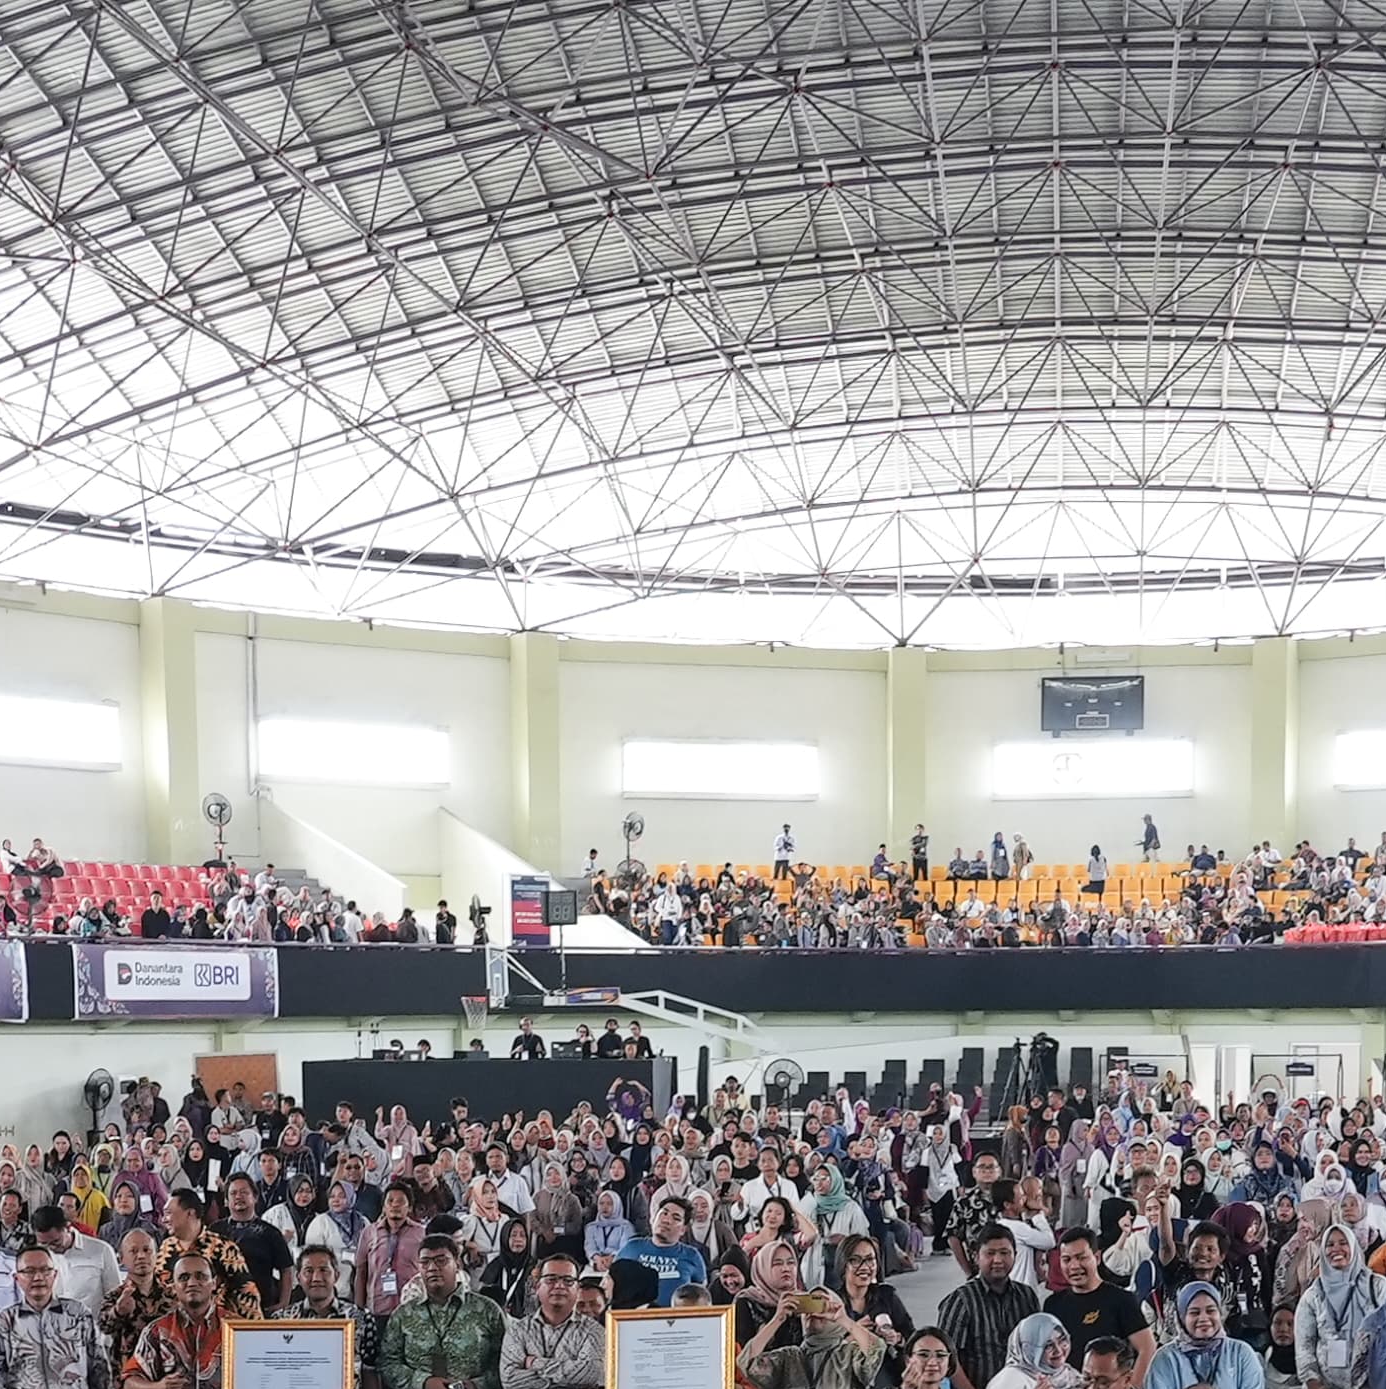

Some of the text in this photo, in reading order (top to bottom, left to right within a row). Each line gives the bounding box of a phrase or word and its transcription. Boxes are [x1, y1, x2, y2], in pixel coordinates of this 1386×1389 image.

[135, 962, 183, 973] Danantara
[135, 975, 181, 986] Indonesia
[212, 966, 239, 985] BRI
